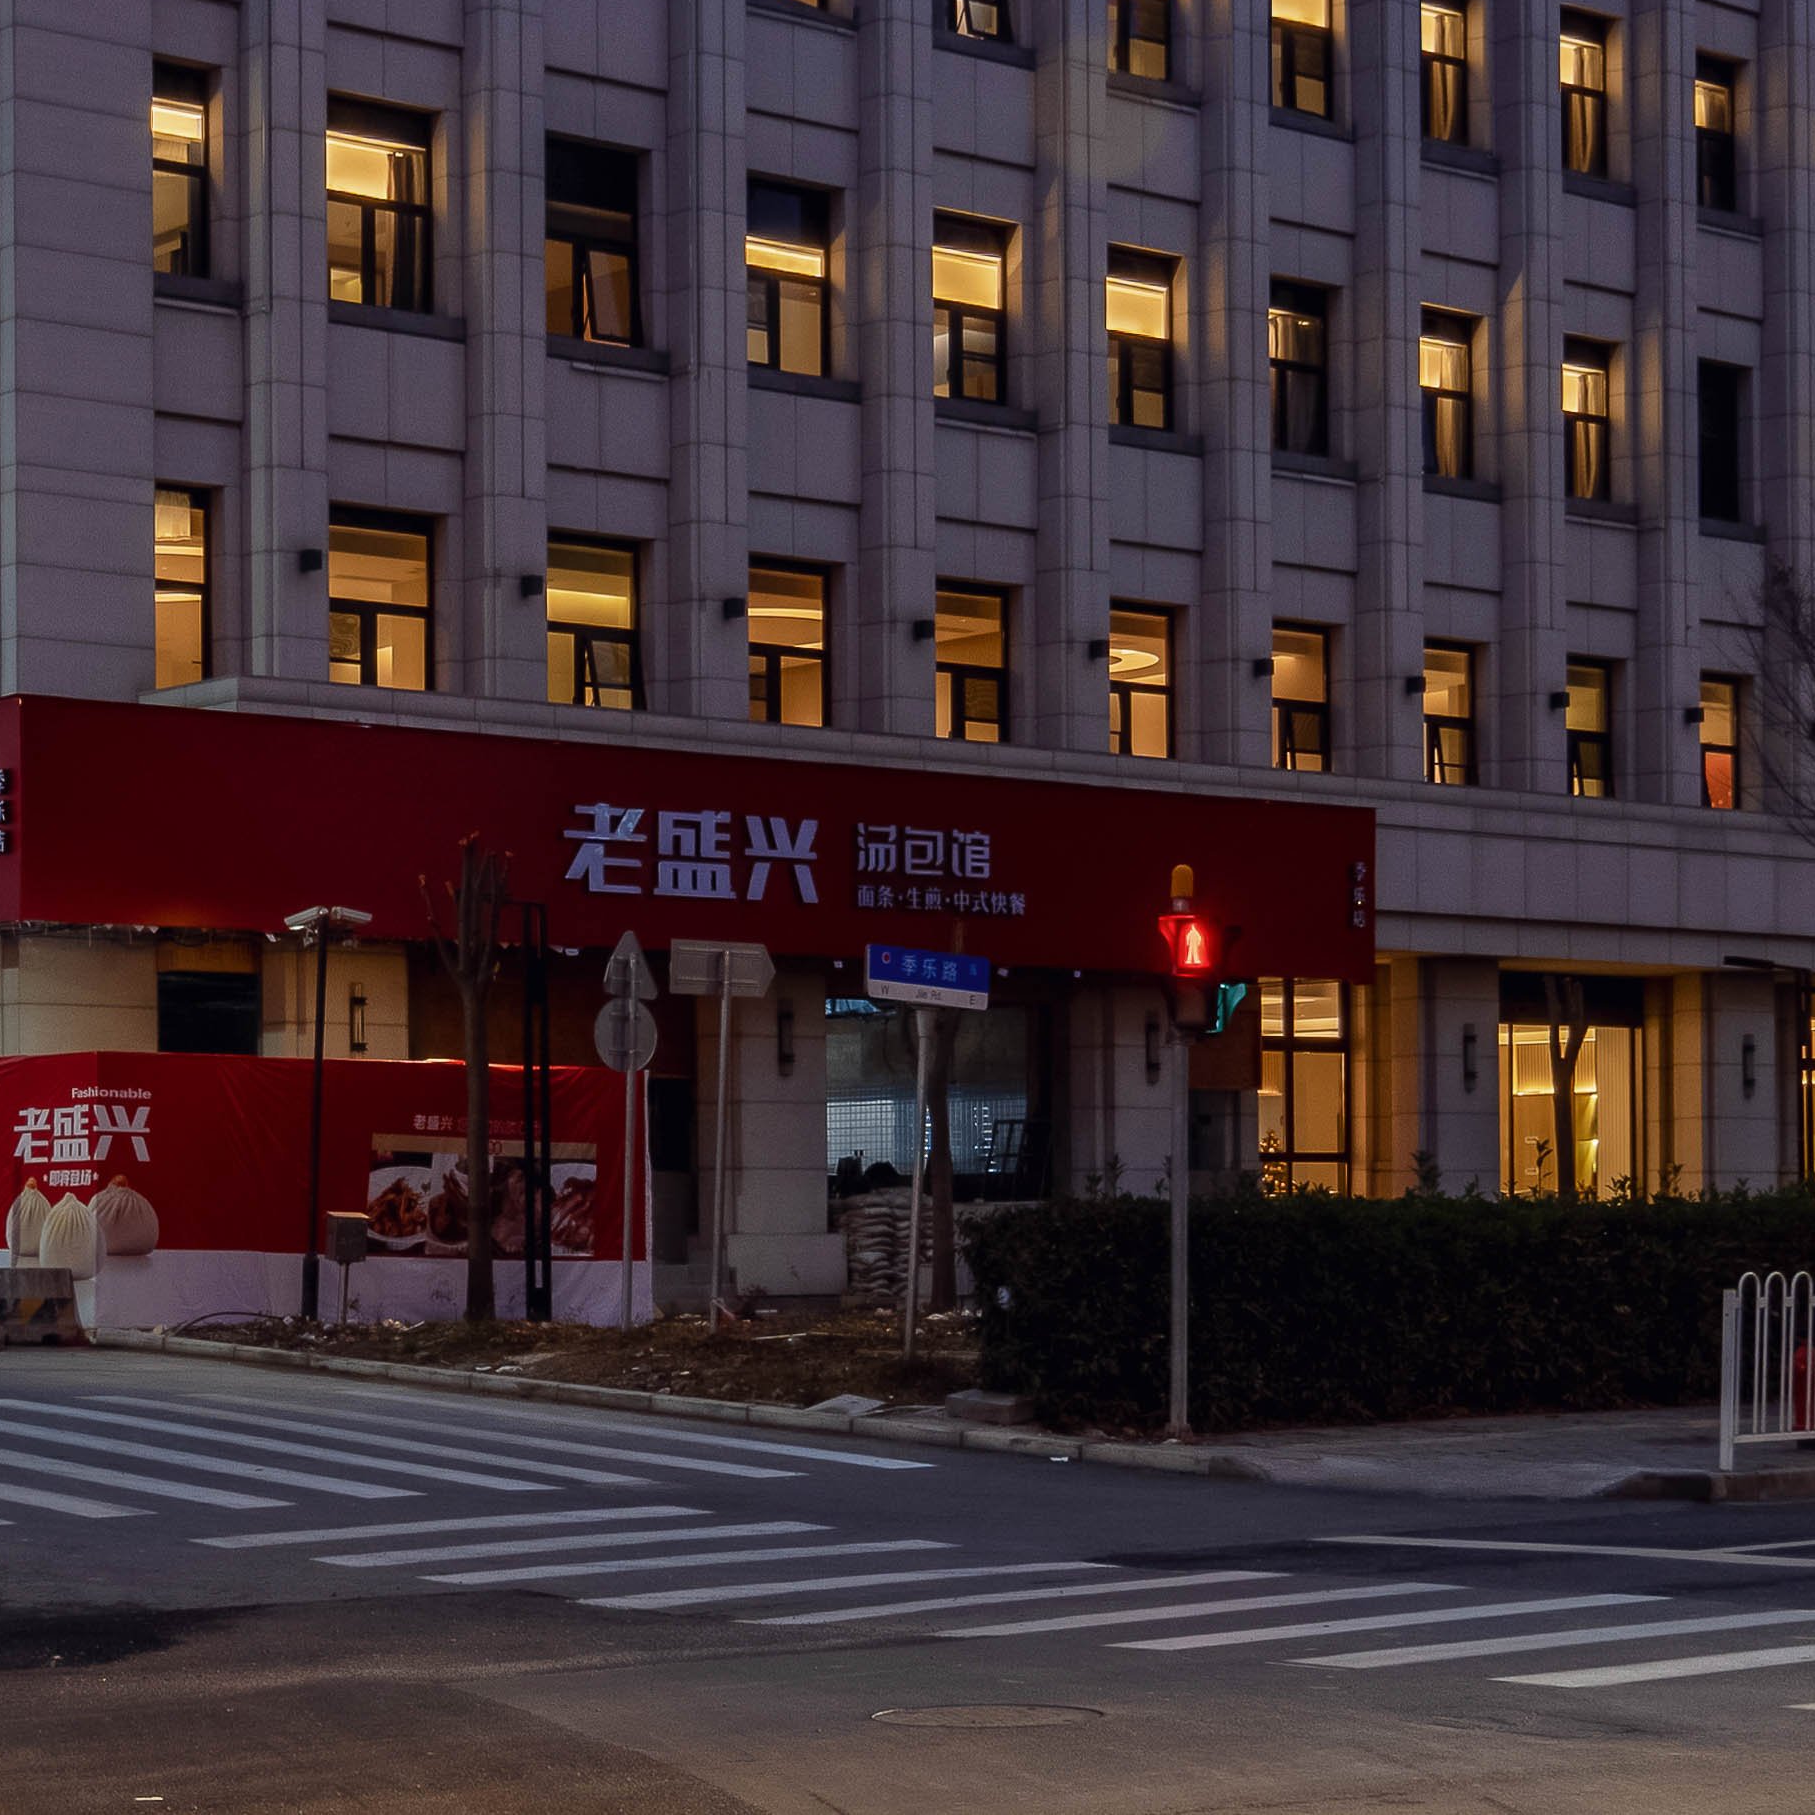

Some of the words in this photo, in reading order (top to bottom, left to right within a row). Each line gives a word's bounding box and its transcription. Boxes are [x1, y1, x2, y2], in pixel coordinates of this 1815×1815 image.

[563, 801, 819, 905] 老盛兴
[856, 821, 992, 880] 汤包馆
[901, 954, 958, 983] 季乐路
[880, 984, 890, 996] W
[969, 995, 977, 1005] E
[71, 1086, 152, 1100] Fashionable
[13, 1103, 152, 1164] 老盛兴
[413, 1114, 454, 1131] 老盛兴
